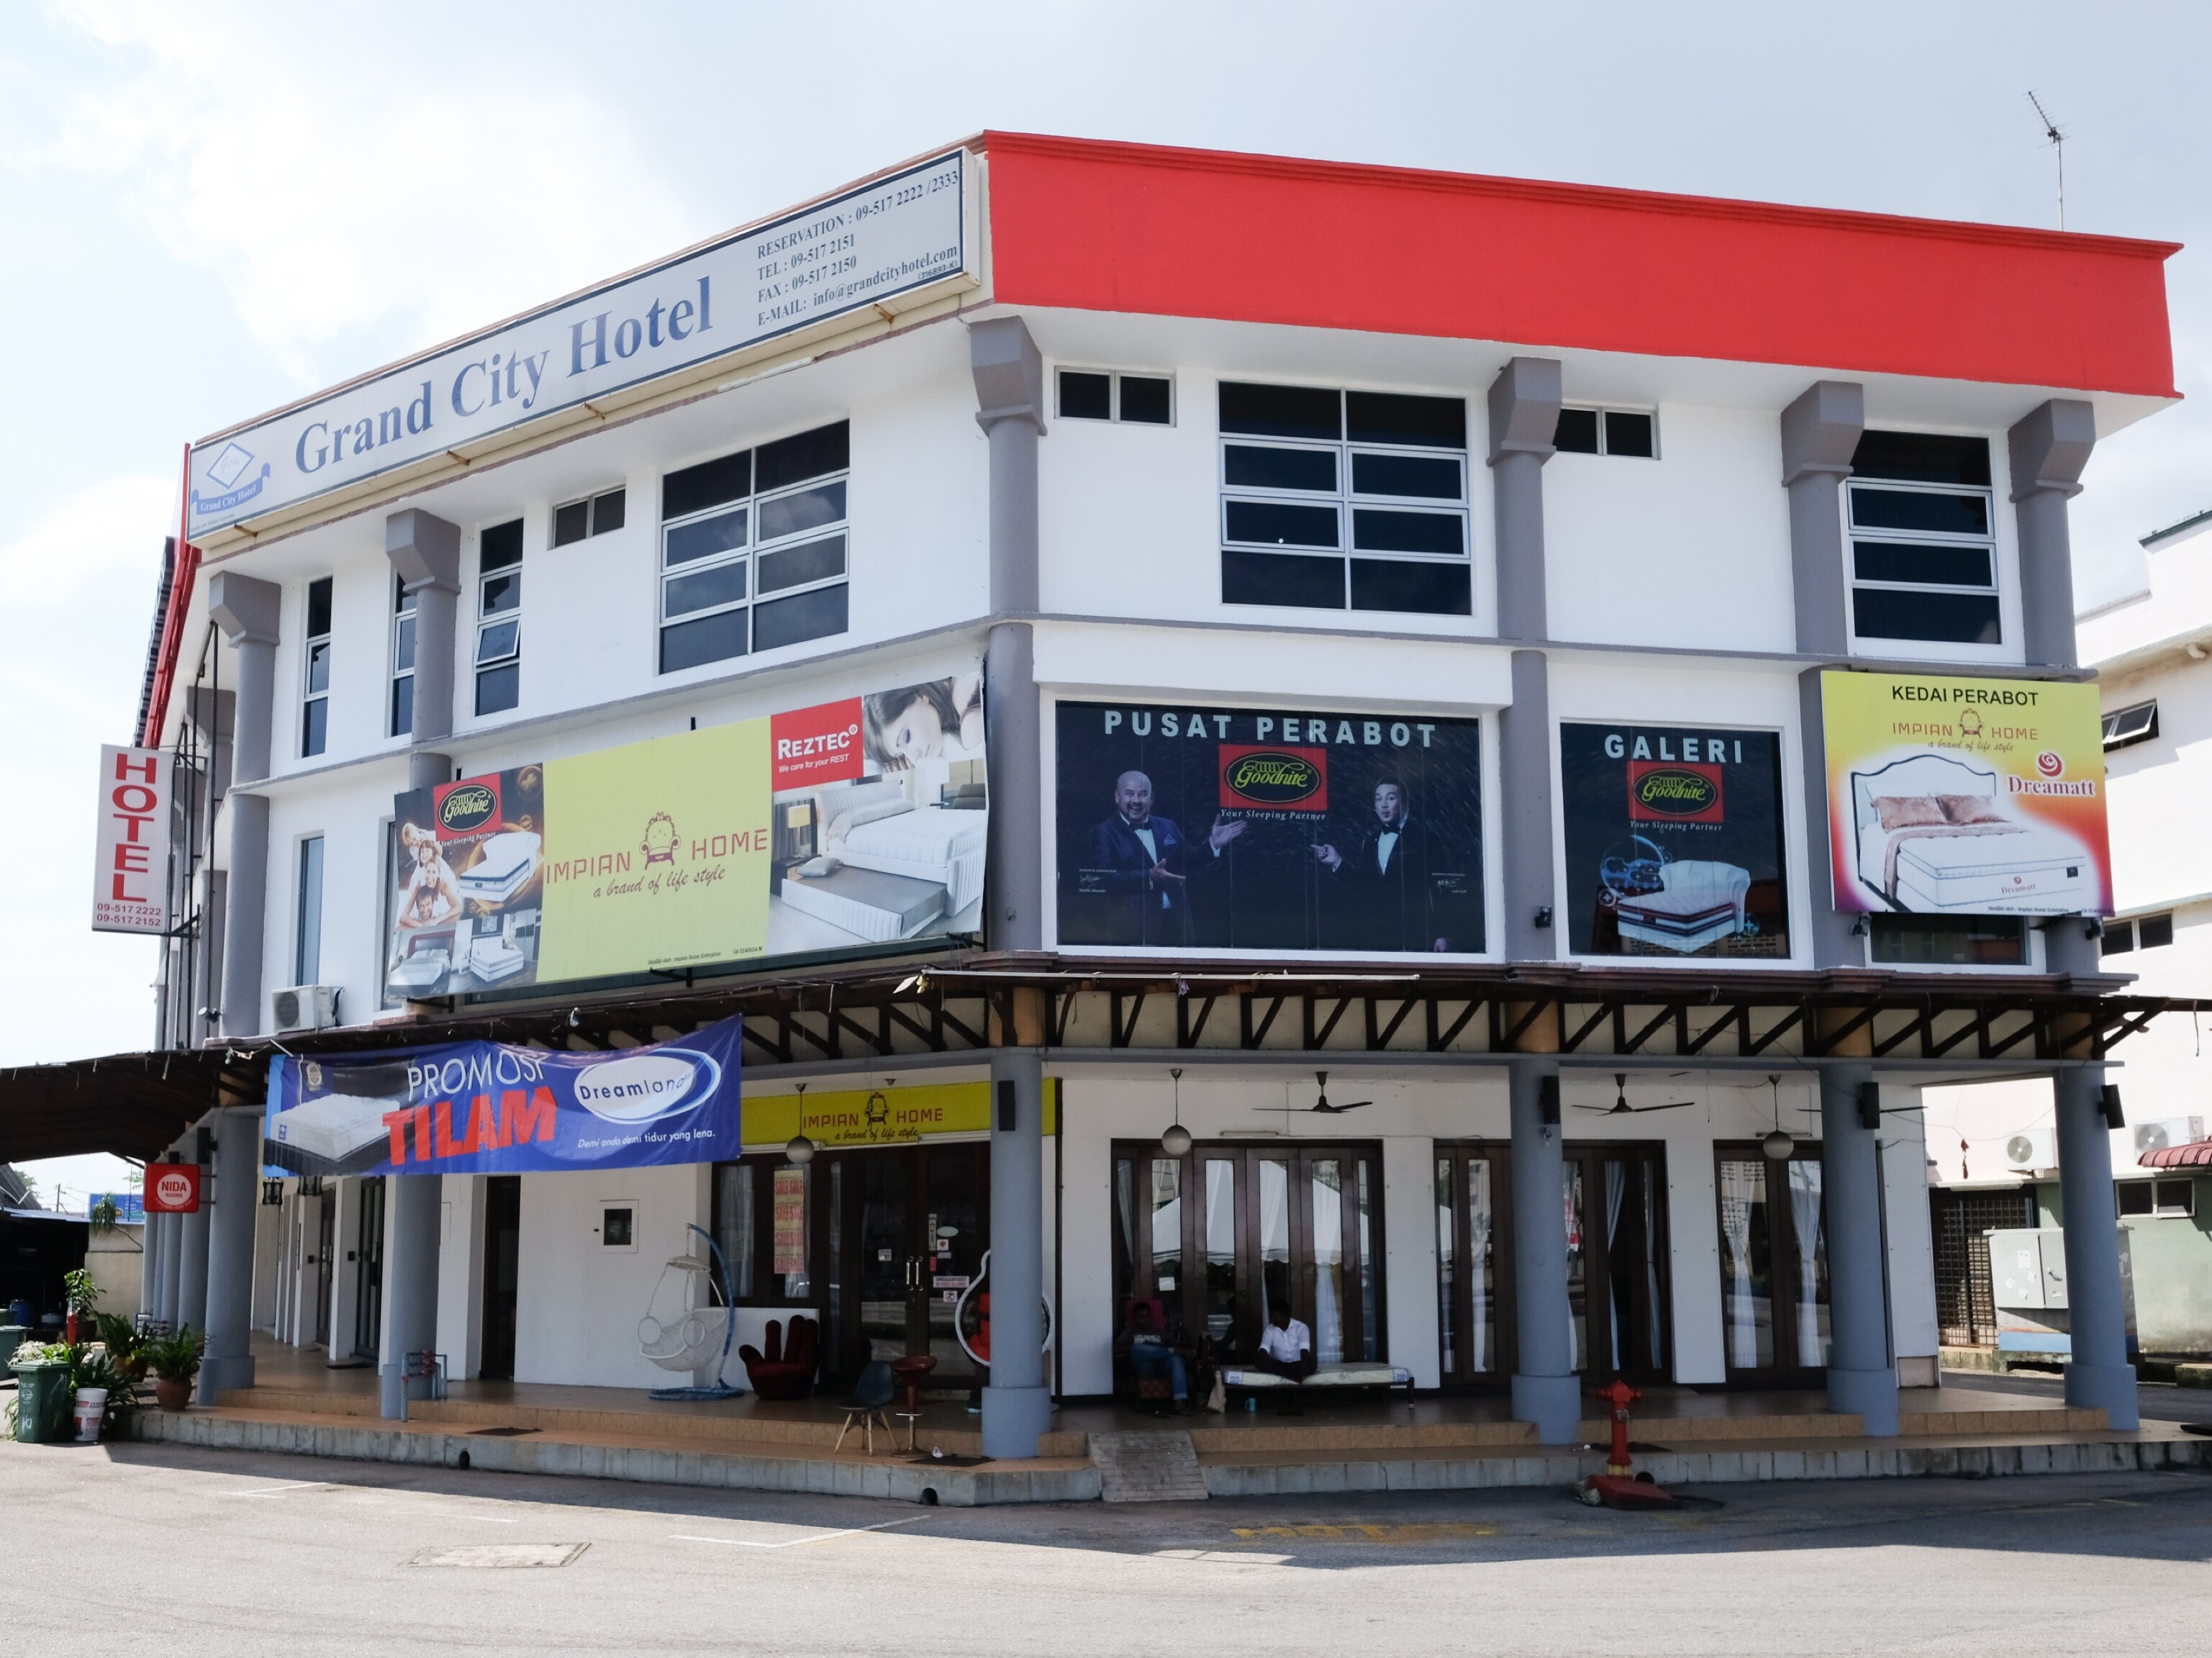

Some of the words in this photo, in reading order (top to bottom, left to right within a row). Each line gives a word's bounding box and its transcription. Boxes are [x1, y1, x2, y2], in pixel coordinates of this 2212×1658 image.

[758, 214, 844, 259] RESERVATION
[856, 195, 893, 222] 09-517
[897, 184, 923, 207] 2222
[926, 171, 958, 195] /2333
[757, 261, 781, 281] TEL
[791, 243, 826, 268] 09-517
[830, 233, 855, 255] 2151
[758, 283, 781, 303] FAX
[792, 266, 827, 289] 09-517
[831, 255, 856, 277] 2150
[813, 245, 958, 307] info@grandcityhotel.com
[295, 381, 434, 474] Grand
[450, 349, 550, 417] City
[566, 276, 714, 379] Hotel
[201, 500, 222, 512] Grand
[222, 497, 235, 507] City
[238, 484, 256, 501] Hotel
[1892, 685, 1947, 702] KEDAI
[1953, 689, 2039, 706] PERABOT
[1105, 710, 1232, 740] PUSAT
[1256, 717, 1435, 748] PERABOT
[1893, 722, 1952, 736] IMPIAN
[1991, 727, 2039, 740] HOME
[1604, 734, 1742, 764] GALERI
[1937, 739, 1962, 749] brand
[1965, 740, 1973, 752] of
[1977, 740, 1991, 752] life
[1994, 742, 2014, 755] style
[815, 759, 829, 769] your
[830, 753, 850, 764] REST
[1235, 760, 1309, 788] Goodnite
[1642, 776, 1706, 802] Goodnite
[2008, 776, 2095, 796] Dreamatt
[444, 790, 489, 823] Goodnite
[1246, 810, 1286, 820] Sleeping
[1289, 812, 1326, 820] Partner
[112, 753, 157, 902] HOTEL
[1630, 820, 1650, 829] Your
[1652, 821, 1687, 832] Sleeping
[1690, 823, 1723, 831] Partner
[453, 835, 475, 845] Sleeping
[546, 851, 631, 884] IMPIAN
[692, 828, 767, 861] HOME
[593, 887, 602, 898] a
[607, 876, 643, 897] brand
[648, 873, 661, 895] of
[666, 869, 689, 892] life
[693, 864, 725, 887] style
[2001, 884, 2036, 894] Dreamatt
[96, 914, 133, 924] 09-517
[135, 916, 161, 926] 2152
[97, 903, 135, 914] 09-517
[136, 906, 161, 915] 2222
[382, 1086, 558, 1166] TILAM
[803, 1113, 858, 1128] IMPIAN
[897, 1108, 943, 1123] HOME
[578, 1138, 599, 1149] Demi
[601, 1138, 620, 1147] anda
[622, 1134, 642, 1145] demi
[644, 1132, 667, 1143] tidur
[670, 1132, 691, 1143] yang
[693, 1128, 715, 1138] lena.
[843, 1128, 866, 1140] brand
[870, 1128, 877, 1141] of
[881, 1128, 895, 1141] life
[161, 1181, 187, 1192] NIDA
